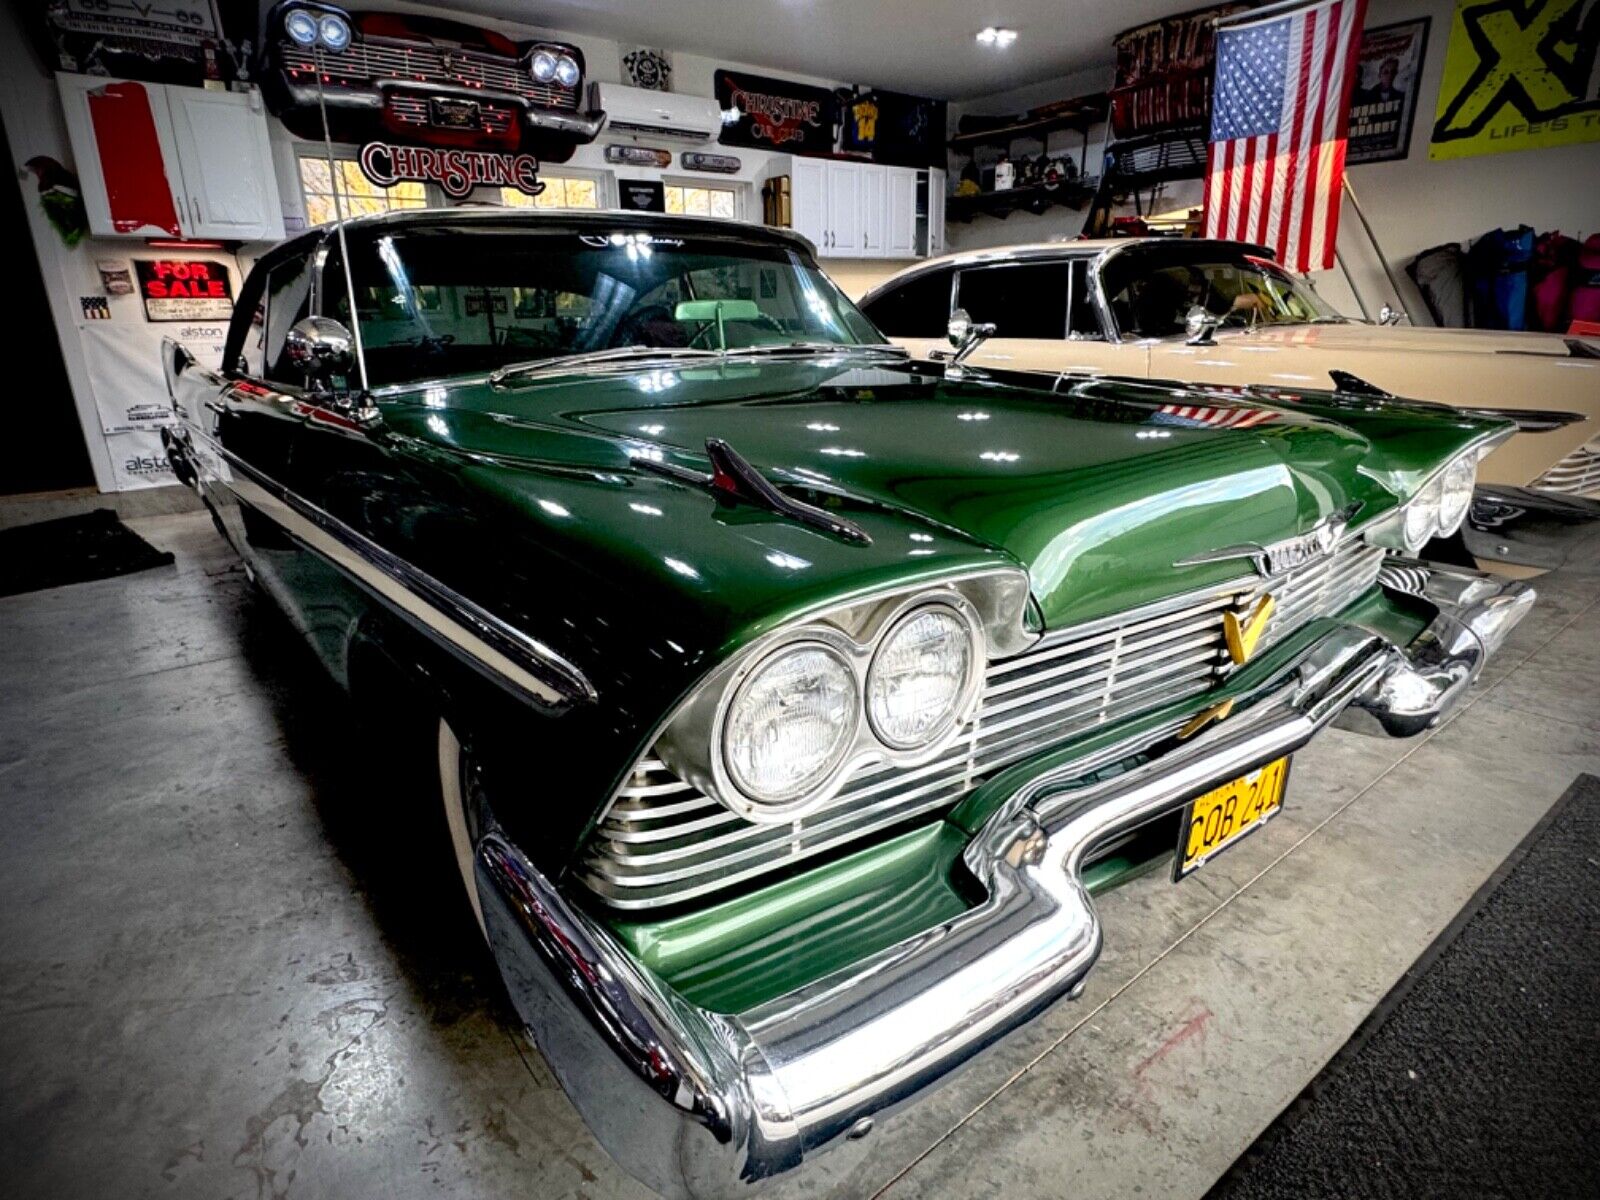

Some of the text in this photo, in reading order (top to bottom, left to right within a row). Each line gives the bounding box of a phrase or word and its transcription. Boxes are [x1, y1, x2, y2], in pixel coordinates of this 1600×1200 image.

[731, 89, 821, 127] CHRISTINE
[1490, 113, 1600, 140] LIFE'S T
[362, 142, 546, 197] CHRISTINE
[154, 261, 210, 280] FOR
[147, 281, 225, 298] SALE
[181, 327, 223, 337] alston
[1240, 766, 1280, 827] 241
